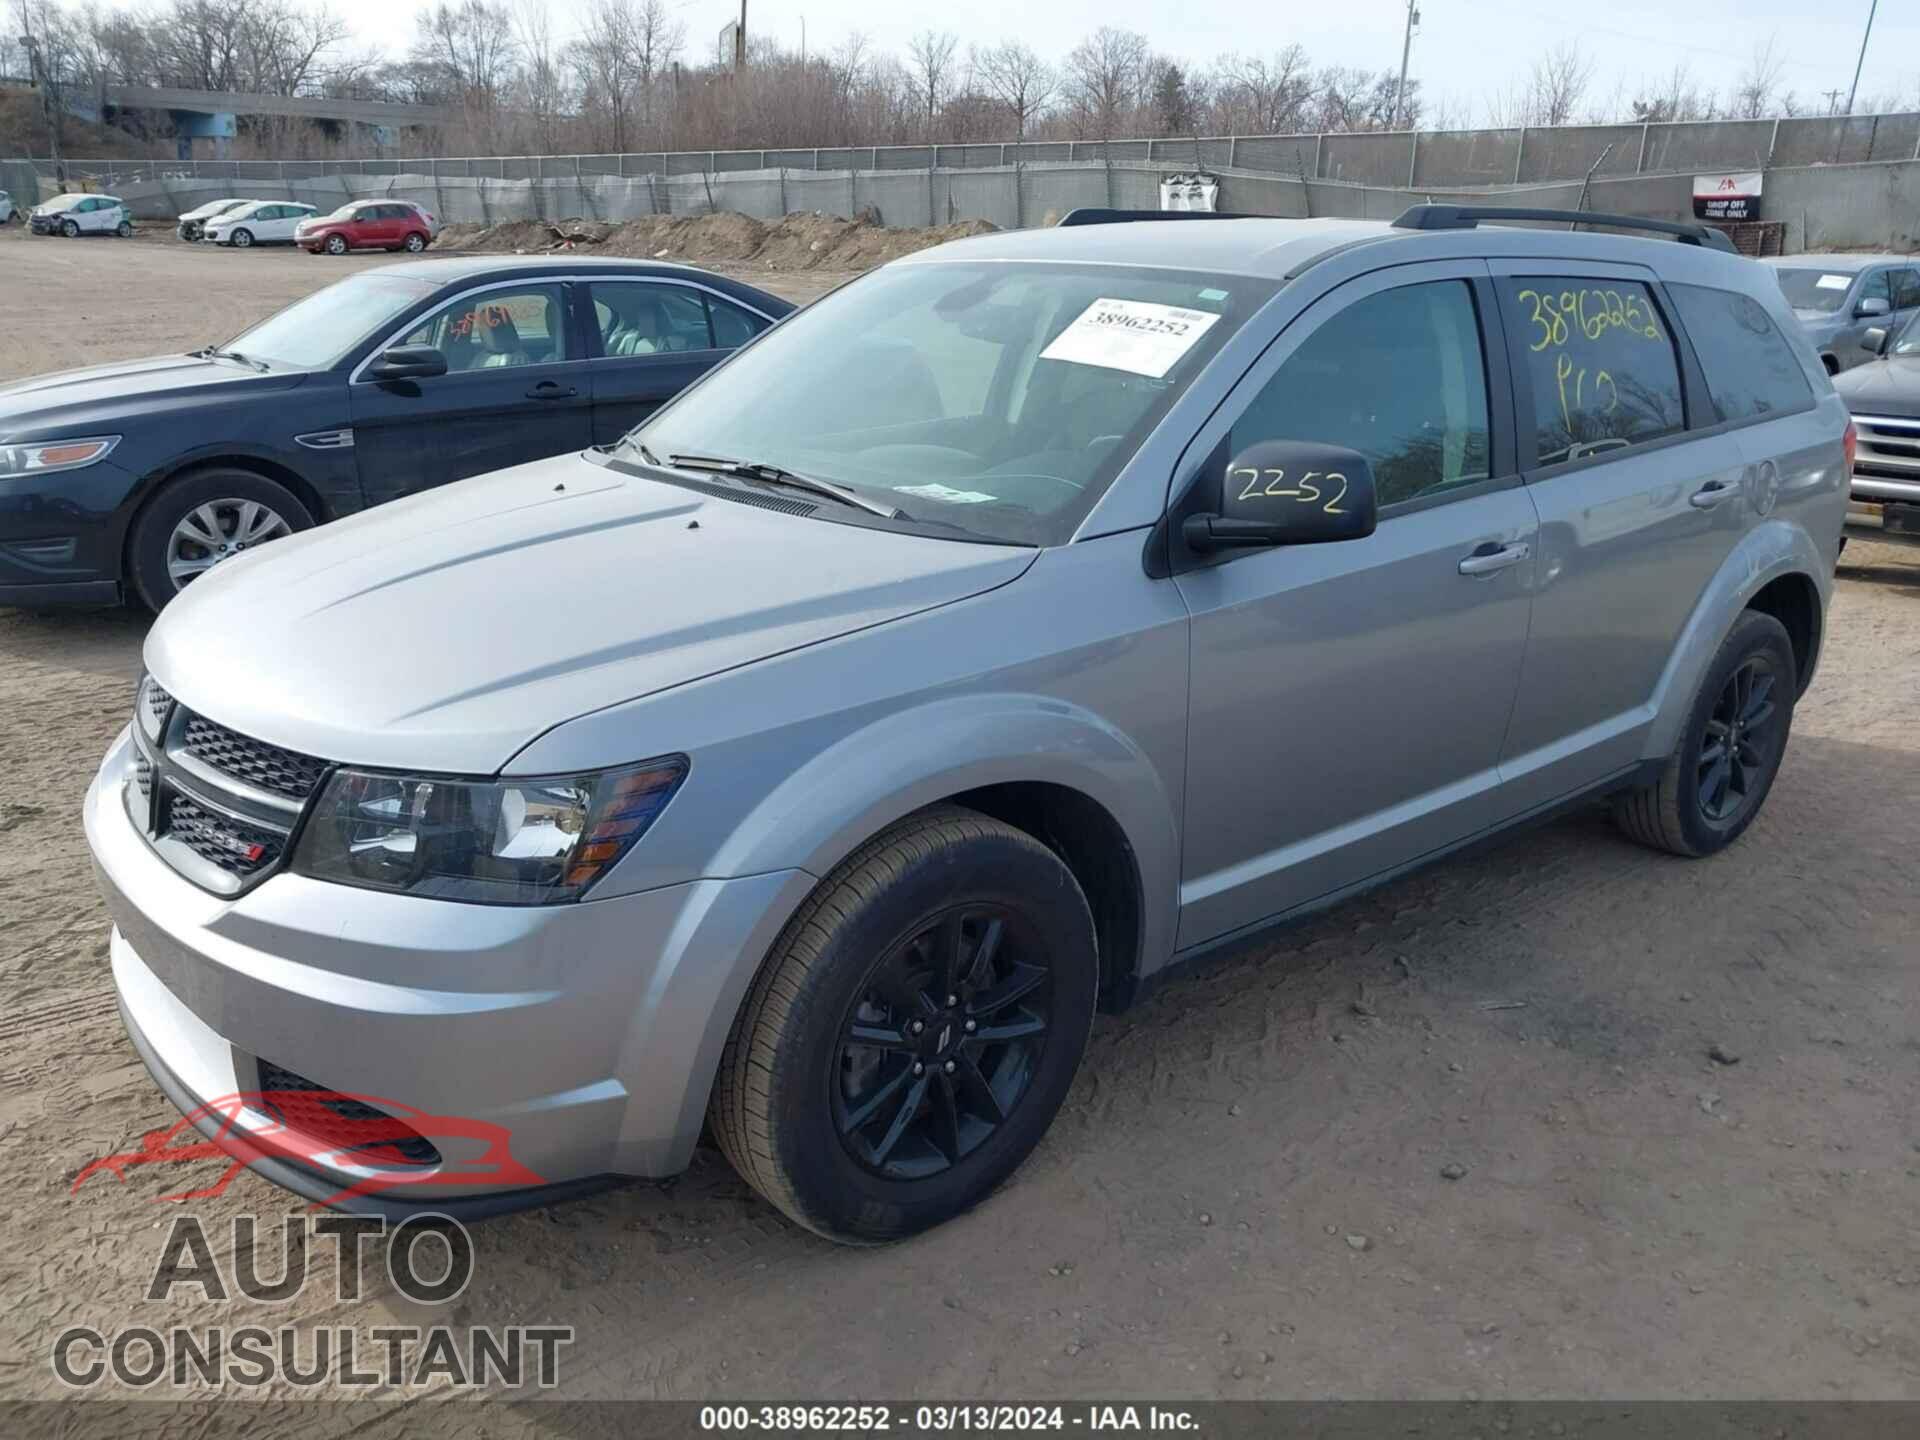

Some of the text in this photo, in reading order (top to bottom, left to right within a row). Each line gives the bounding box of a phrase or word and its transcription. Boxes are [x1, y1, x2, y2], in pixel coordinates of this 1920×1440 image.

[1727, 208, 1748, 218] ONLY
[1730, 200, 1746, 209] OFF
[1089, 311, 1190, 336] 38962252
[1519, 289, 1663, 352] 38962252
[1234, 468, 1350, 513] 2252
